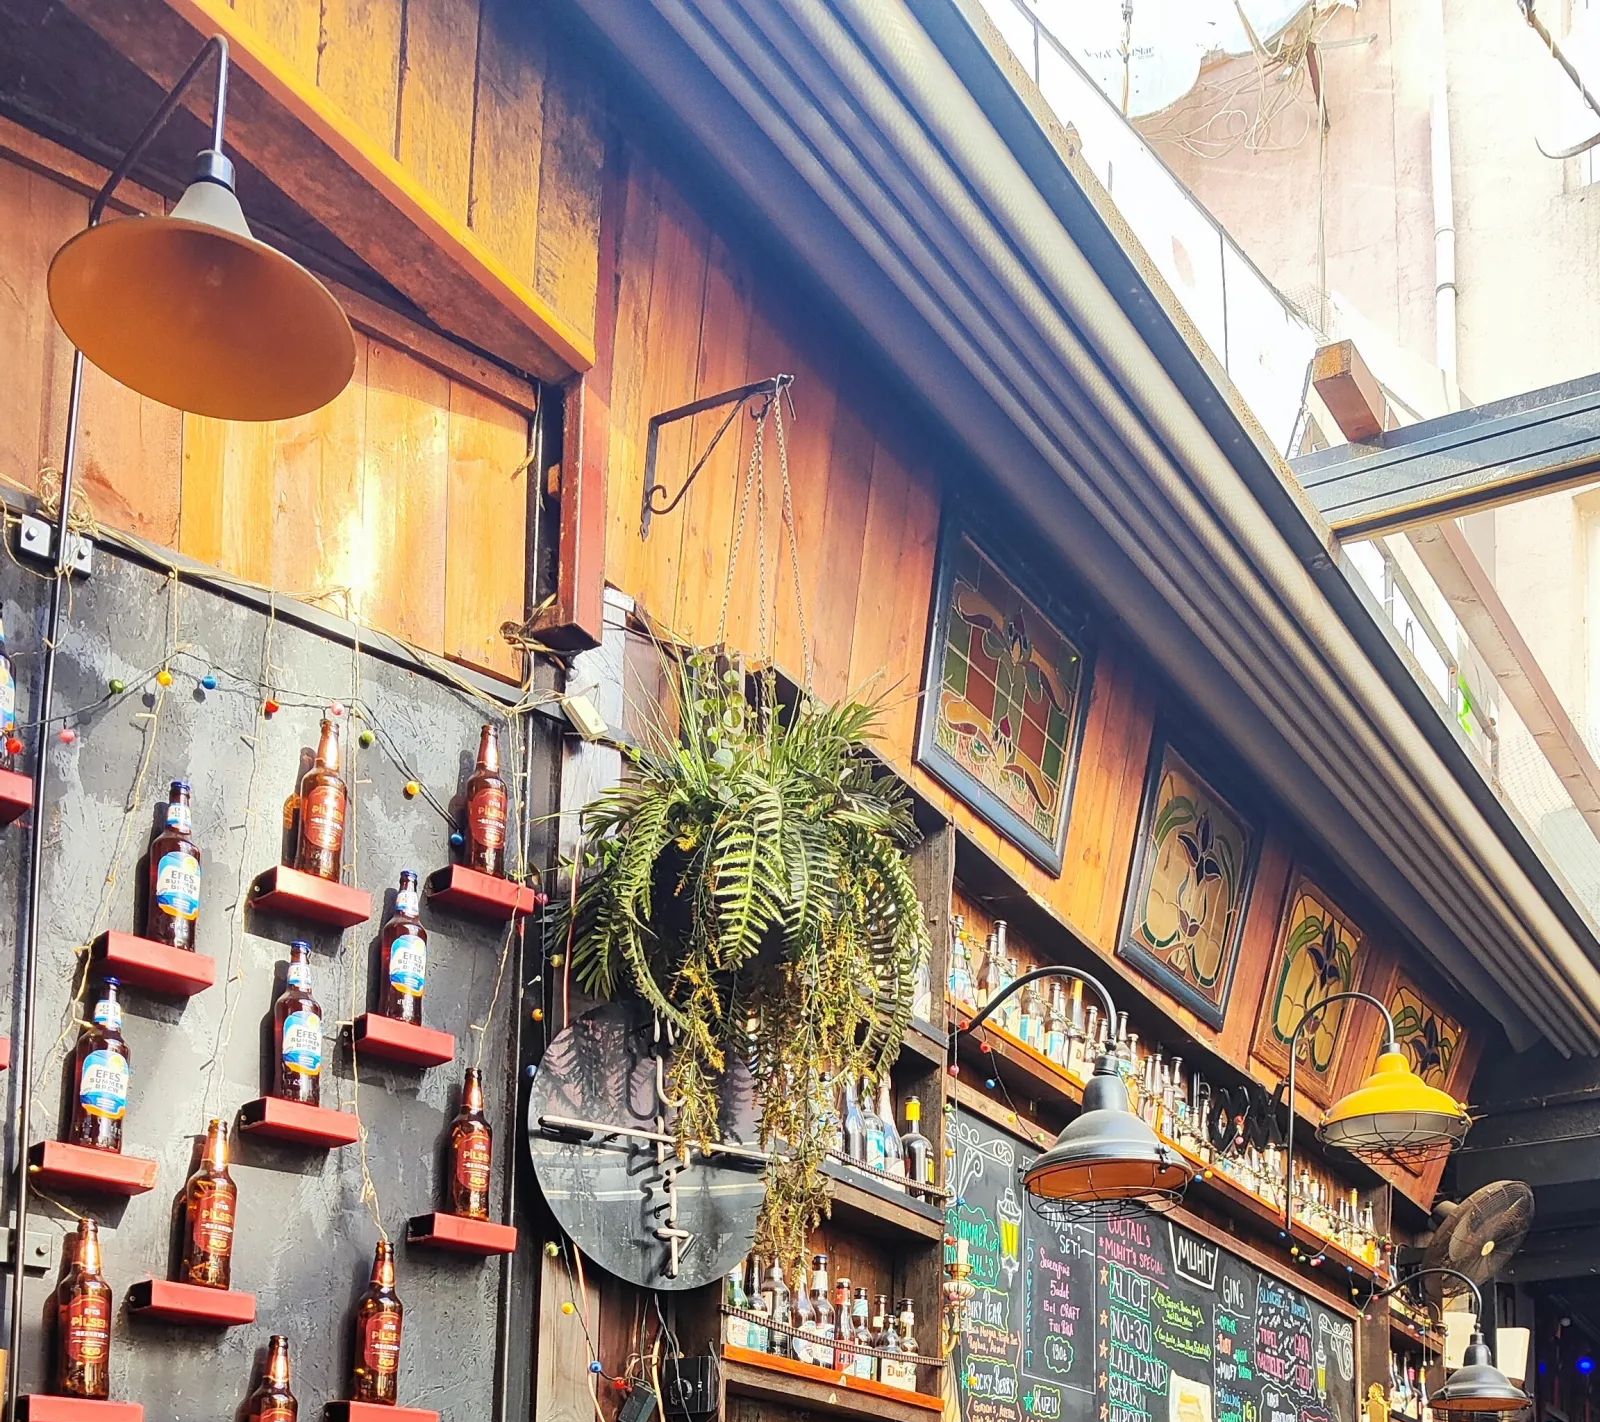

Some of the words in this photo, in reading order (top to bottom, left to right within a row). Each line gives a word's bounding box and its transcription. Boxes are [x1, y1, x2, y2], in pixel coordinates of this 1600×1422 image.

[1178, 1236, 1214, 1281] MUHİT
[1111, 1268, 1148, 1311] ALICE
[1112, 1310, 1150, 1353] NO:30
